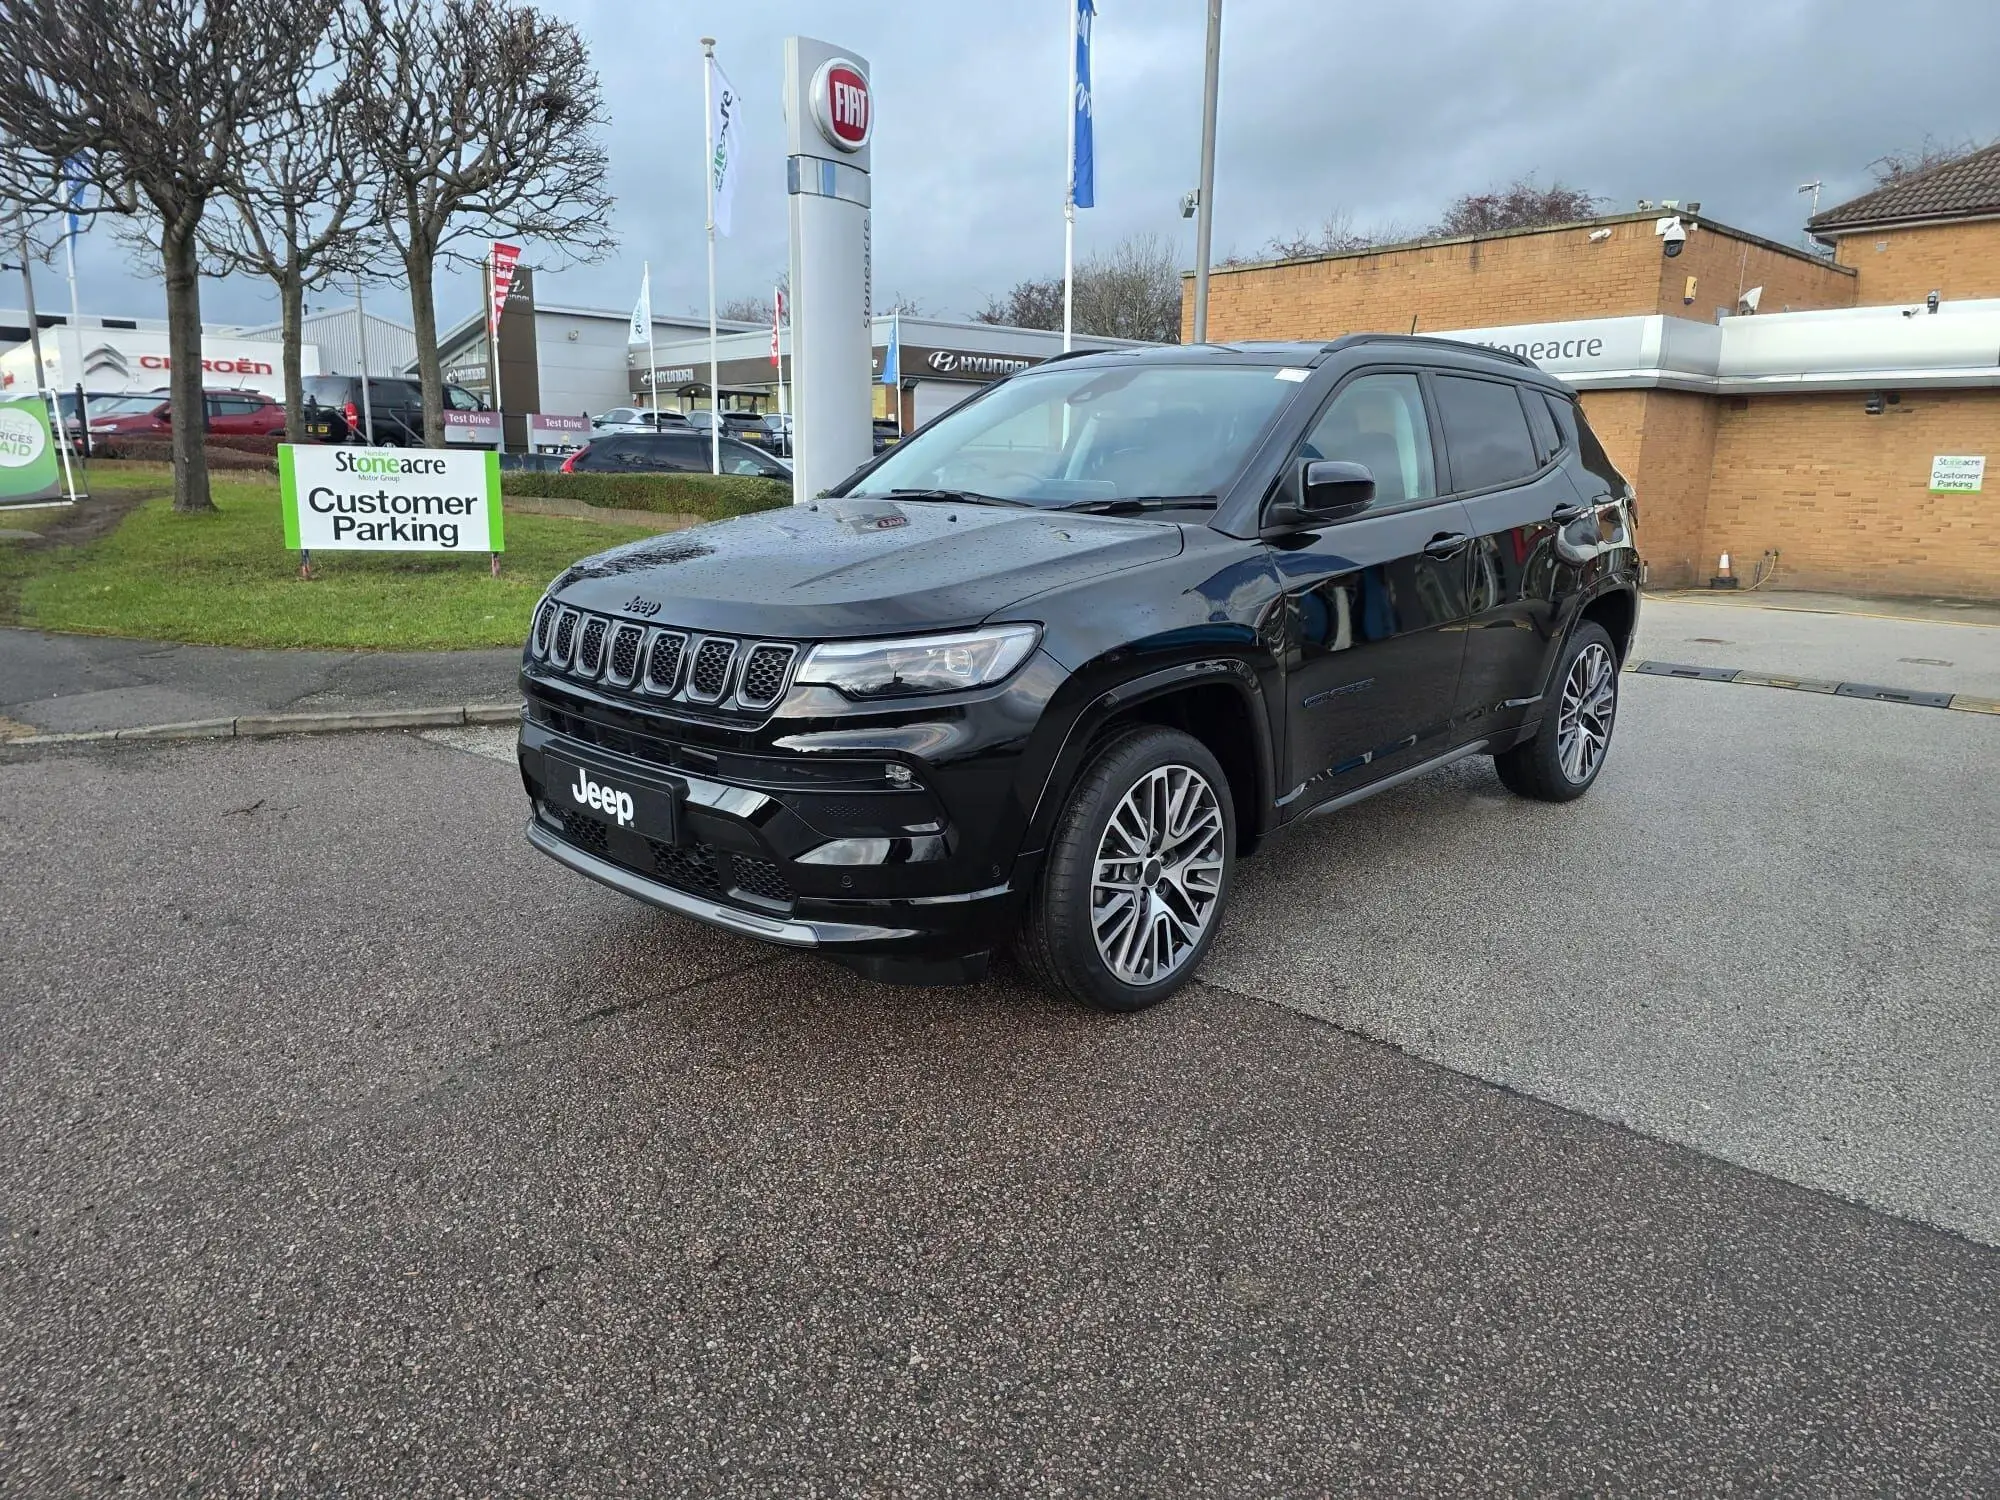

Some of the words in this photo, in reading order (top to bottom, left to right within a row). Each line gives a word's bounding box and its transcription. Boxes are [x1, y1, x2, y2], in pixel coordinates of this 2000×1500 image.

[834, 81, 867, 129] FIAT
[863, 218, 872, 329] Stoneacre
[140, 356, 273, 375] CIROËN
[656, 368, 694, 383] HYUNDAI
[449, 414, 467, 424] Test
[469, 414, 491, 425] Drive
[545, 418, 561, 428] Test
[563, 419, 582, 429] Drive
[0, 431, 33, 444] RICES
[0, 441, 32, 456] AID
[335, 451, 446, 475] Stoneacre
[358, 474, 379, 482] Motor
[380, 474, 400, 483] Group
[1938, 480, 1973, 489] Parking
[308, 486, 478, 515] Customer
[332, 515, 459, 548] Parking
[622, 595, 662, 617] Jeep
[571, 768, 634, 826] Jeep
